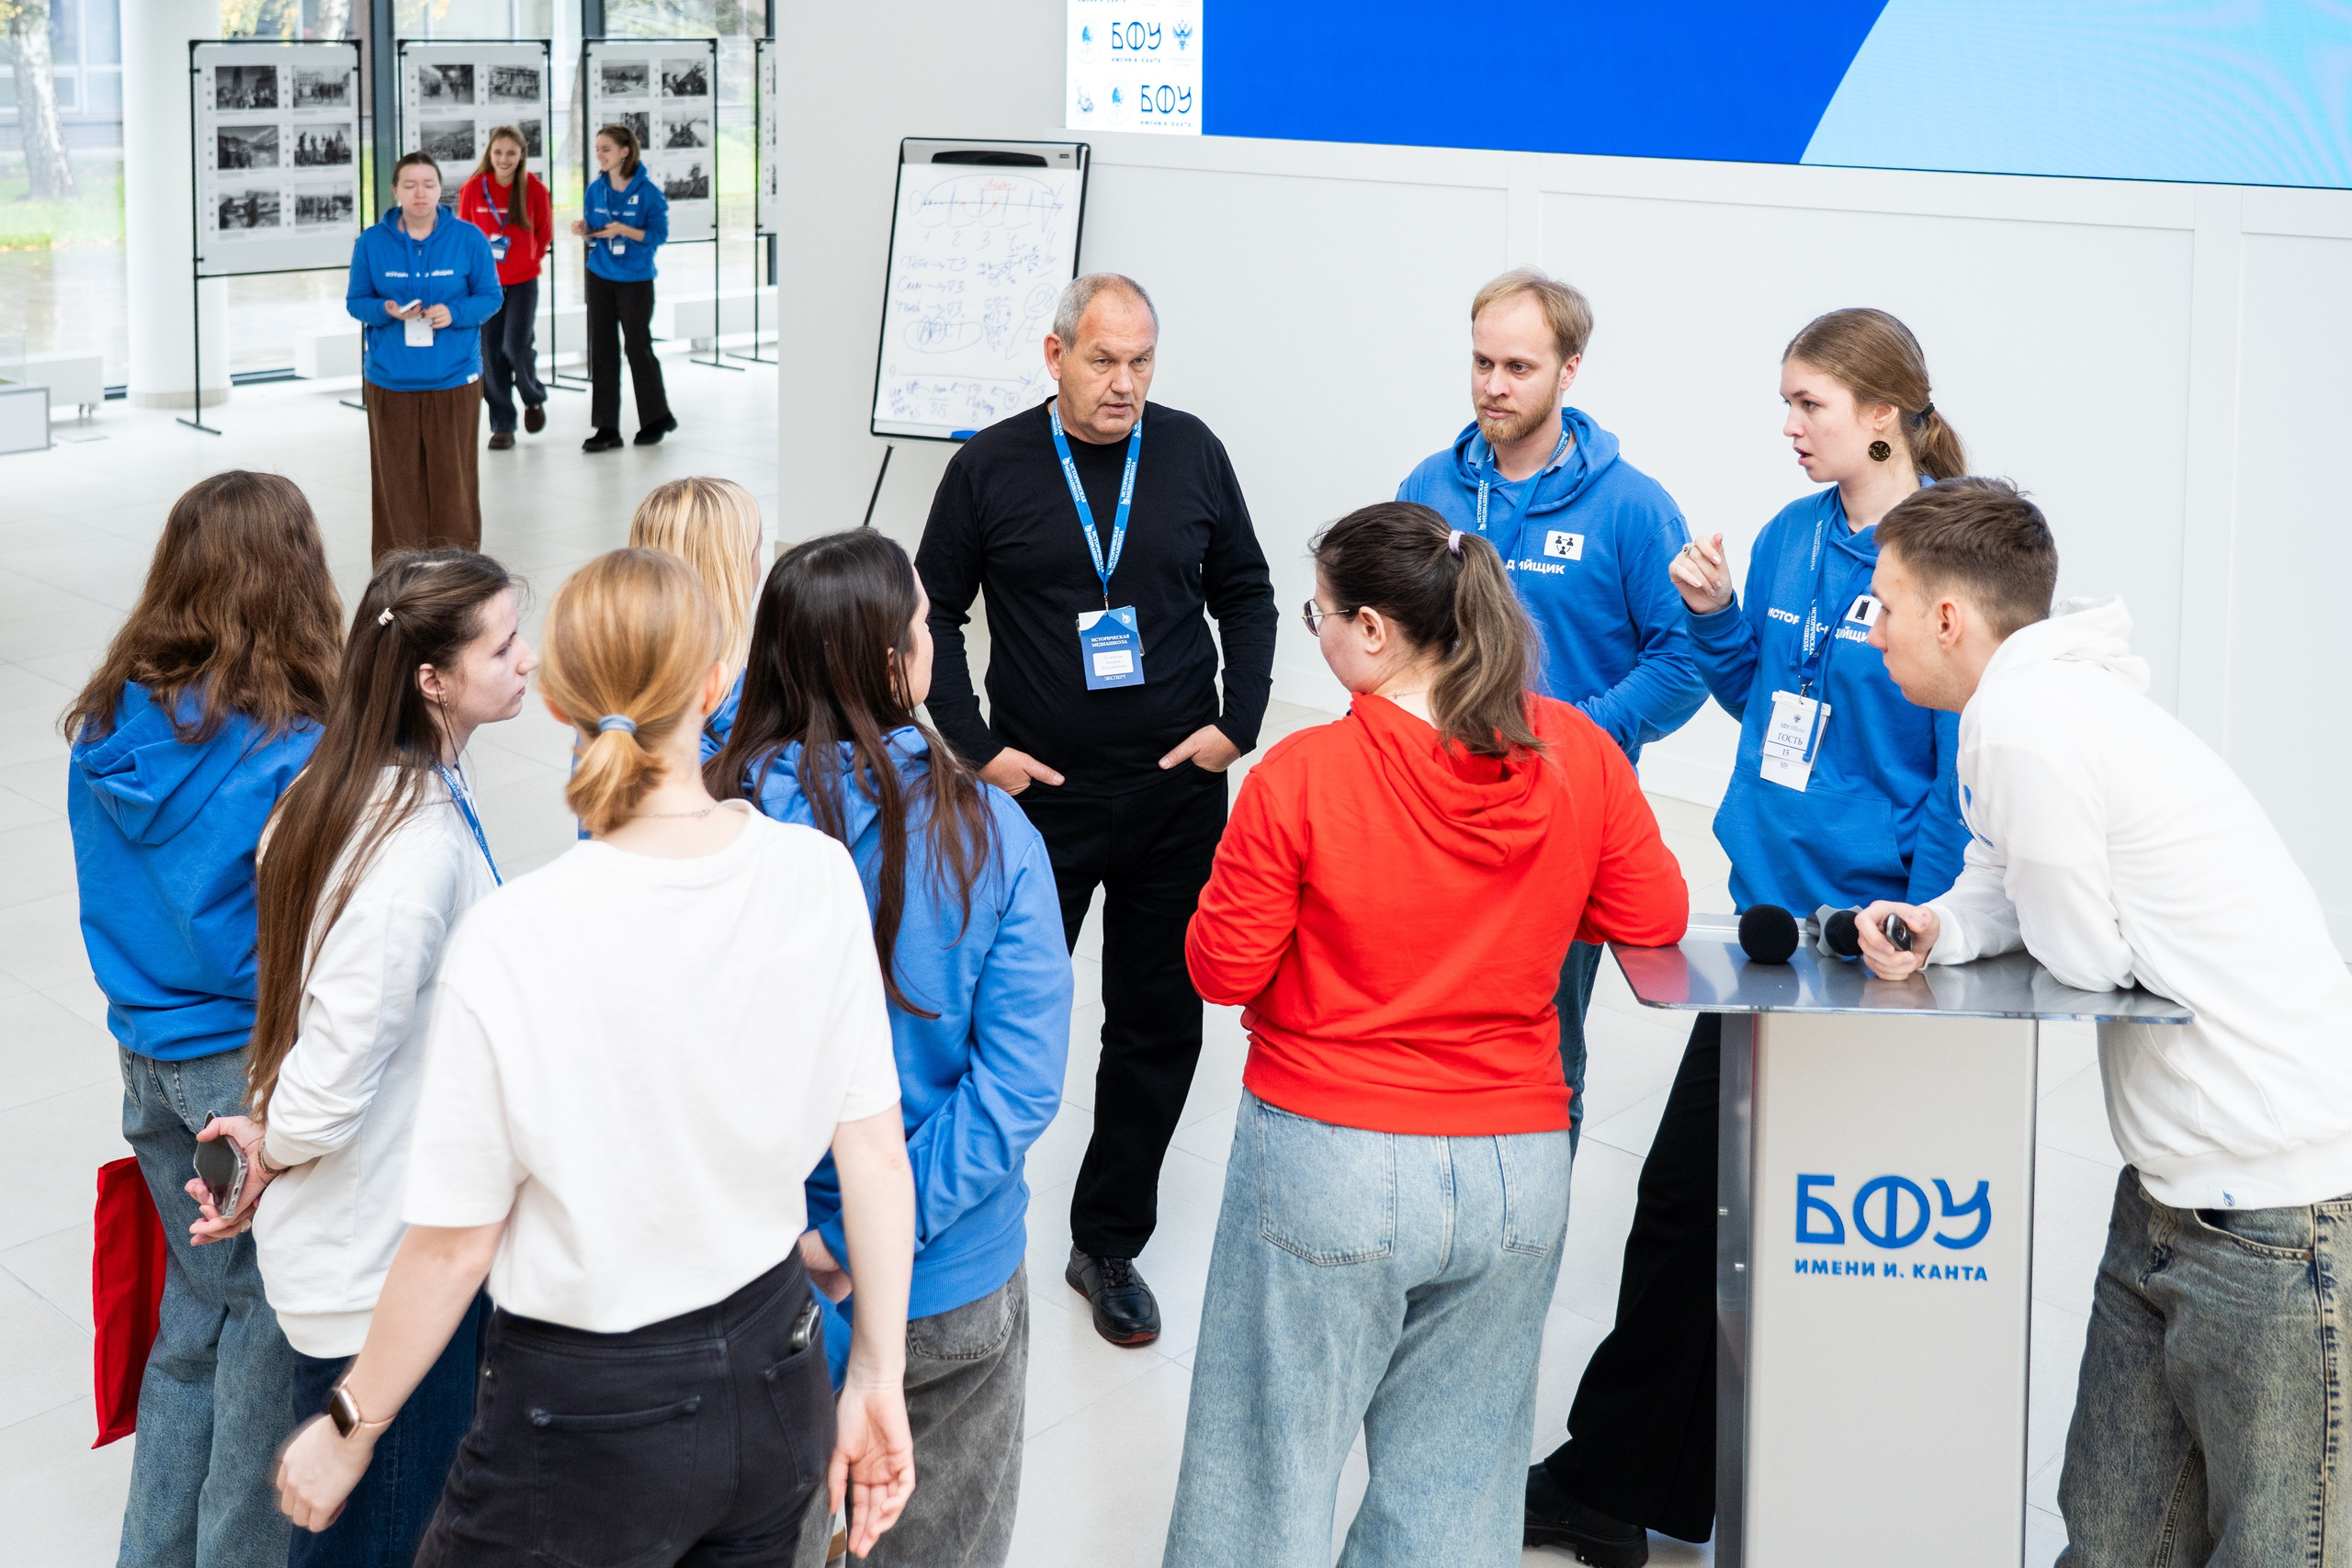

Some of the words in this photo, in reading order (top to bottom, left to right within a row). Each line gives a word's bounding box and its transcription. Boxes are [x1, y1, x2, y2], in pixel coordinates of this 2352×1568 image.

[1112, 21, 1161, 51] БФУ
[1141, 85, 1192, 114] БФУ
[1505, 558, 1566, 575] ДИЙЩИК
[1778, 732, 1803, 746] ГОСТЬ
[1795, 1173, 1992, 1250] БФУ
[1794, 1258, 1875, 1277] ИМЕНИ
[1883, 1262, 1905, 1278] И.
[1913, 1263, 1988, 1281] КАНТА
